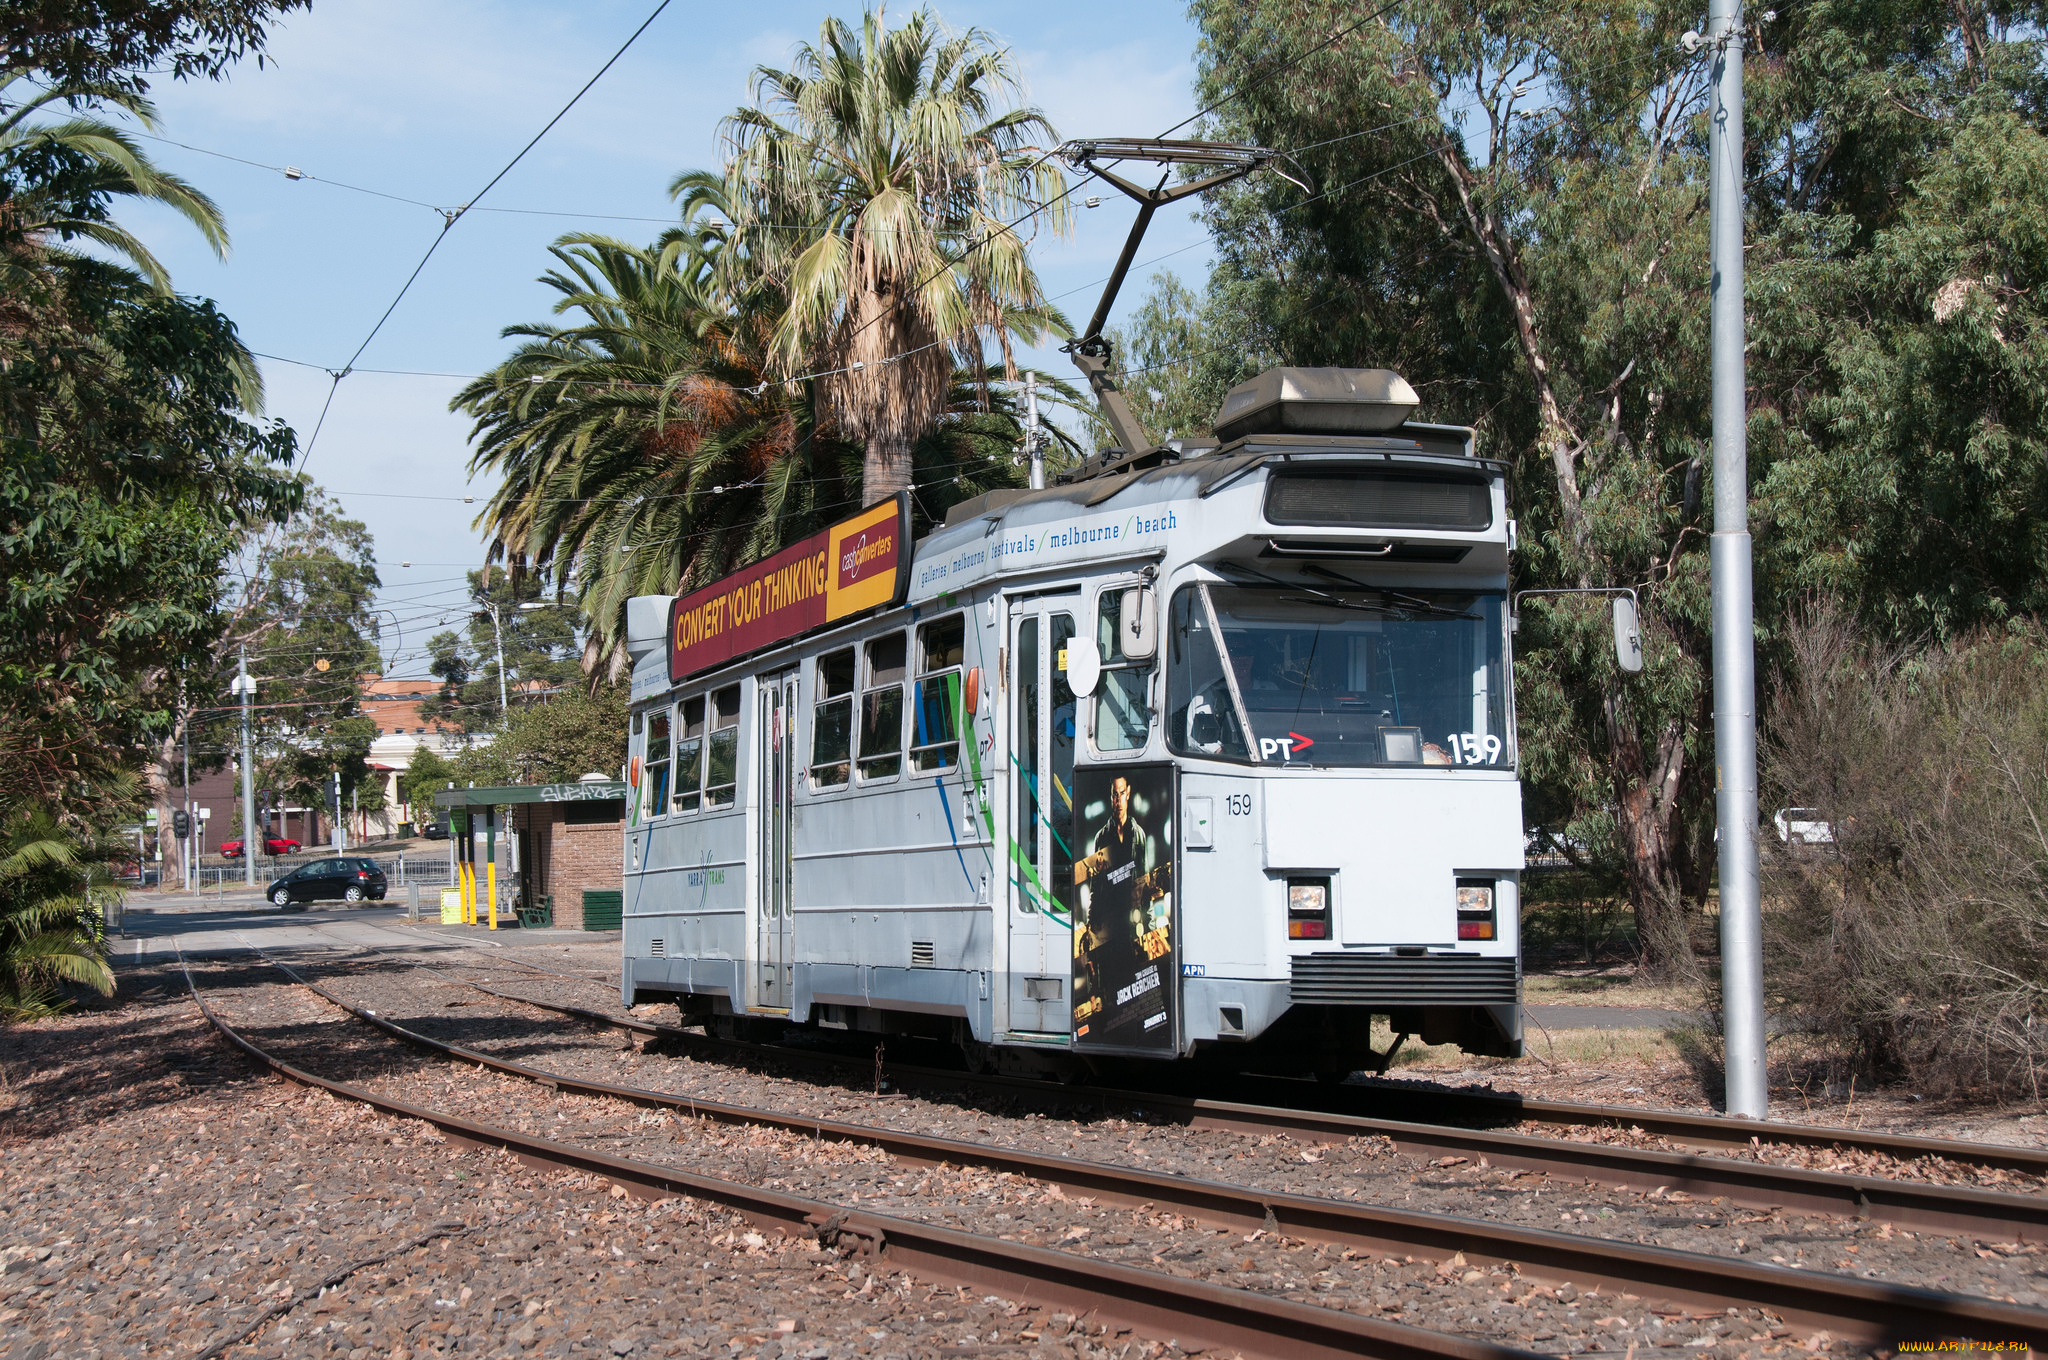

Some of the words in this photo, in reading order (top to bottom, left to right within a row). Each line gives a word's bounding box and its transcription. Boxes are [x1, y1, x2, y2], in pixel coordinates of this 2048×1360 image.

[952, 548, 985, 574] melbourne
[991, 537, 1035, 559] festivals
[1050, 524, 1120, 548] melbourne
[1136, 510, 1178, 535] beach
[676, 596, 727, 652] CONVERT
[727, 579, 762, 629] YOUR
[764, 550, 828, 615] THINKING.
[1260, 738, 1293, 760] PT
[1447, 733, 1502, 764] 159
[1225, 794, 1252, 816] 159
[688, 872, 703, 887] YARRA
[709, 870, 725, 885] TRAMS
[1184, 965, 1204, 976] APN
[1116, 986, 1133, 1006] JACK
[1131, 972, 1161, 998] REACHER
[1143, 1014, 1163, 1029] JANUARY
